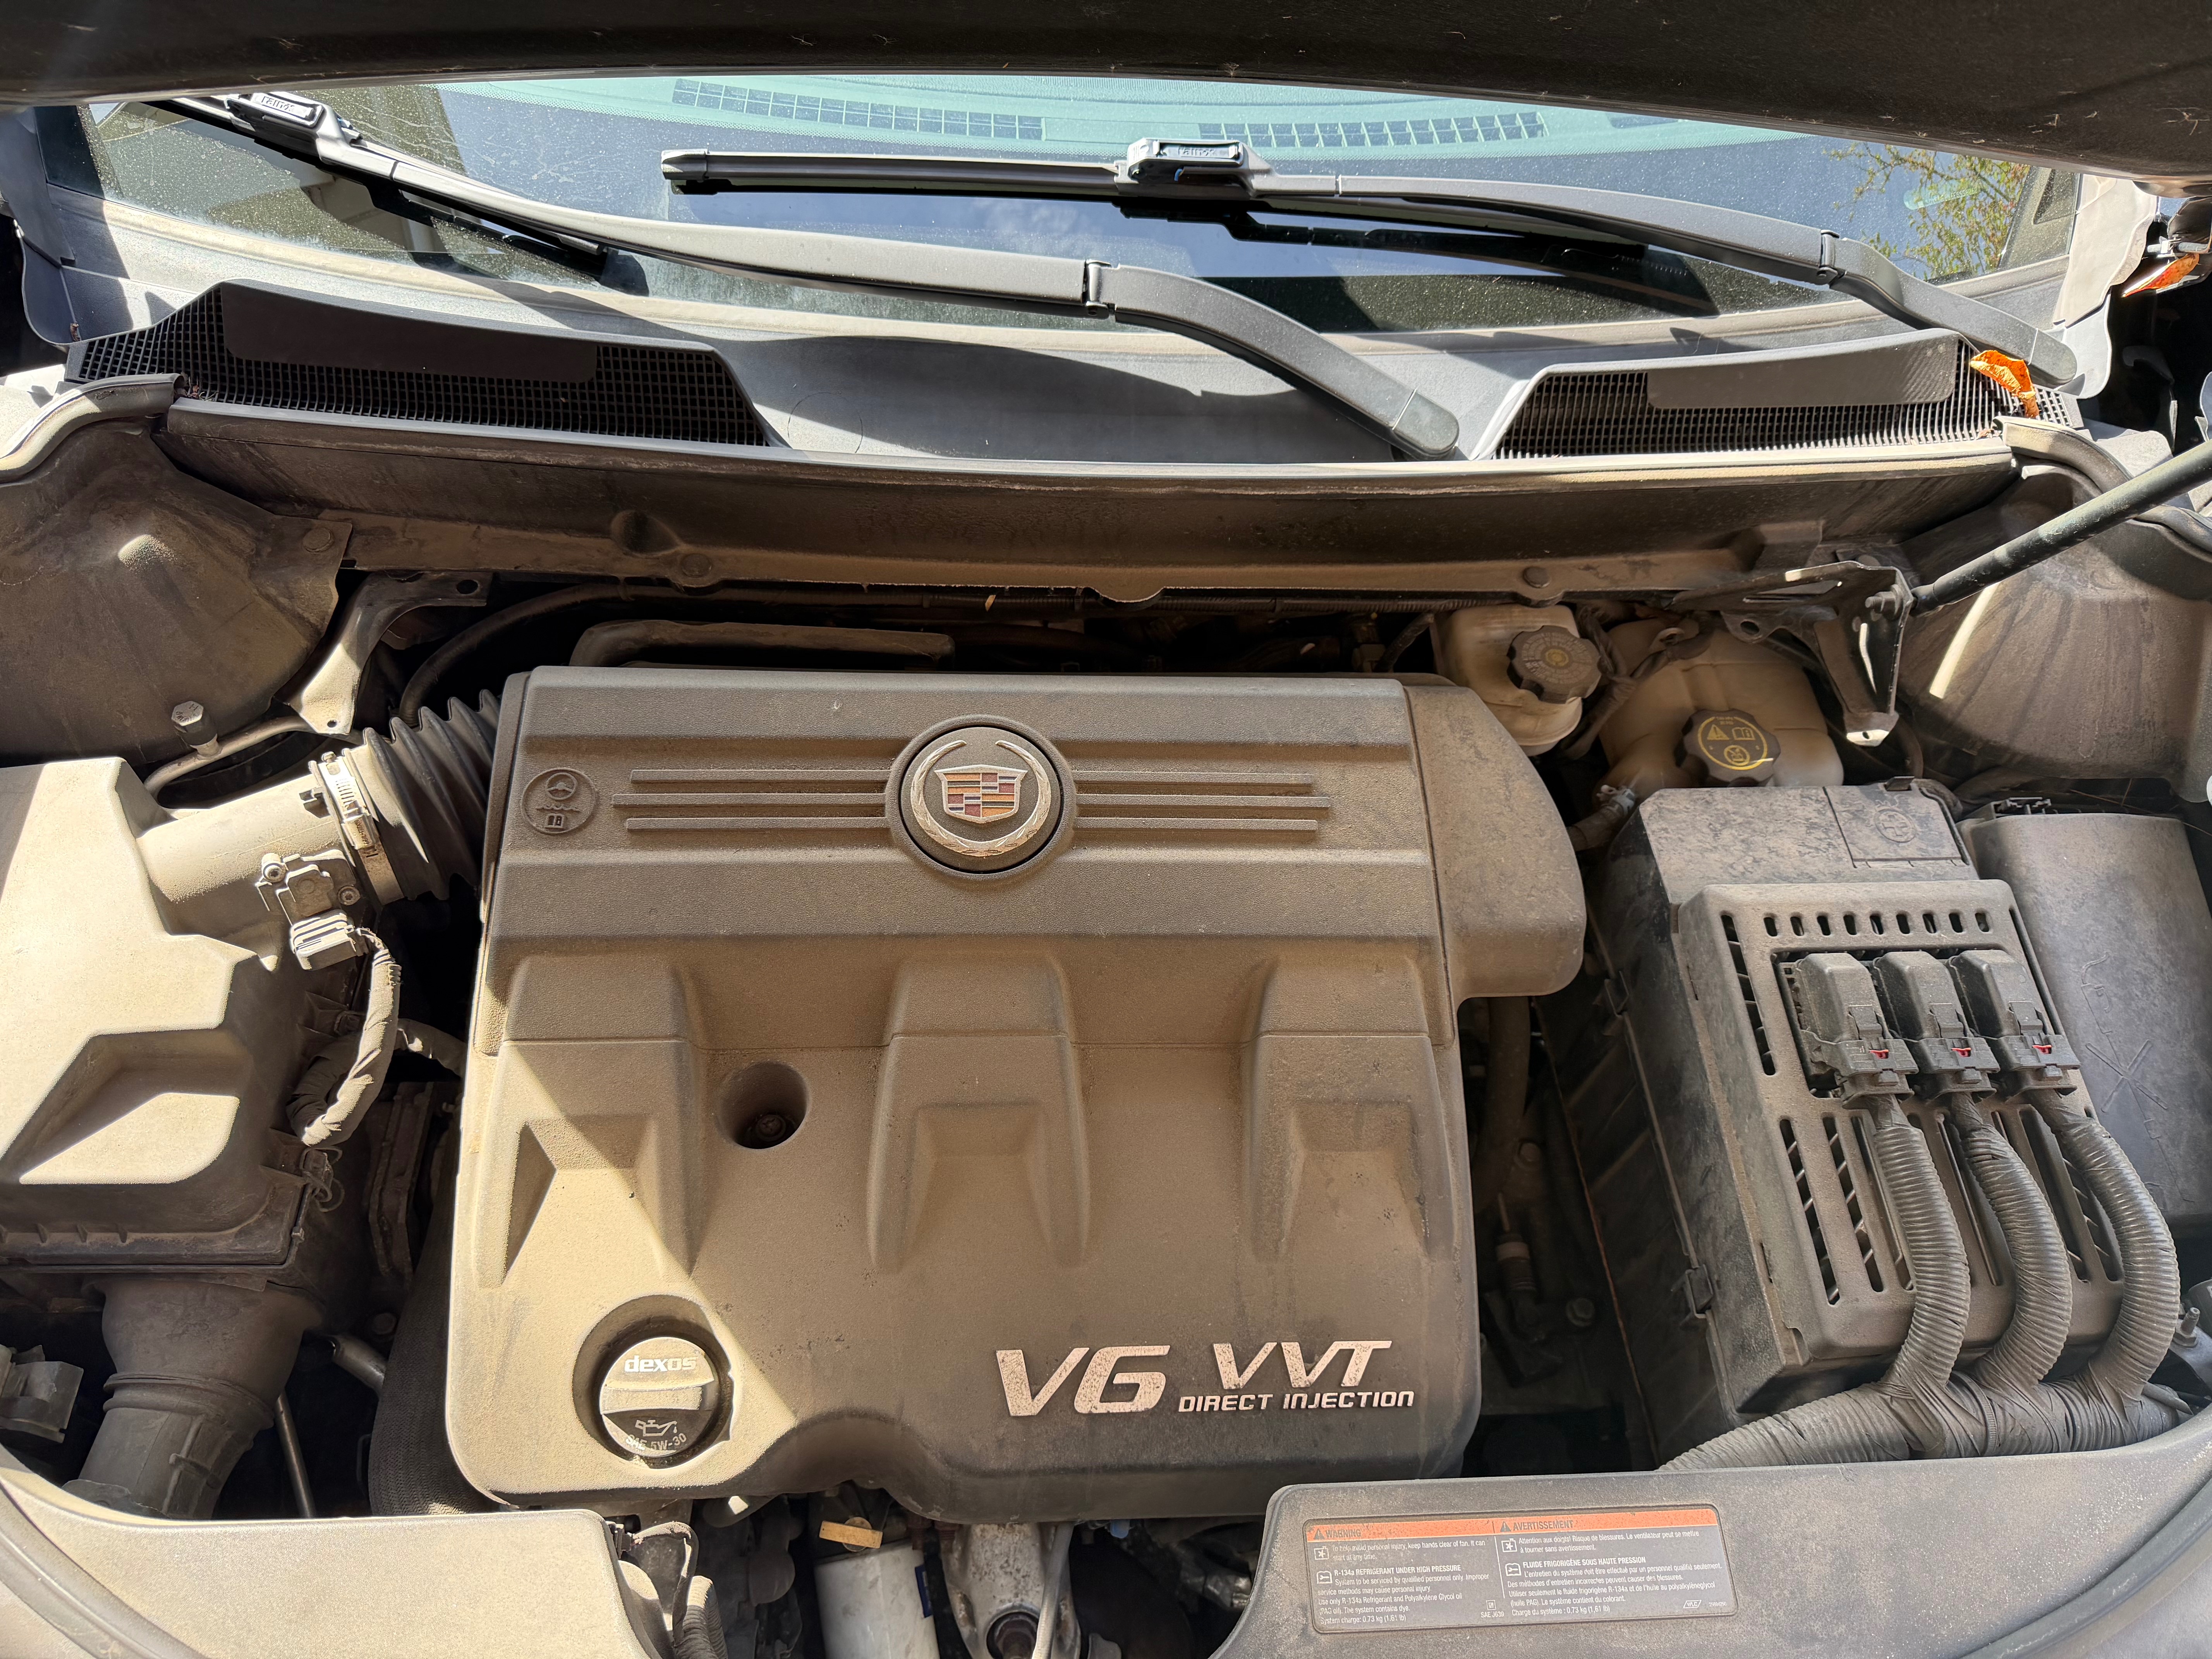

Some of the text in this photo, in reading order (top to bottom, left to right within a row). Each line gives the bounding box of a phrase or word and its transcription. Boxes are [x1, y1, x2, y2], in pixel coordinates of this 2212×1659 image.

[624, 1355, 696, 1372] dexos
[996, 1341, 1392, 1416] V6 VVT
[1178, 1391, 1414, 1412] DIRECT INJECTION
[626, 1432, 687, 1451] SAE 5W-30
[1512, 1519, 1574, 1531] AVERTISSEMENT
[1325, 1528, 1362, 1539] WARNING
[1553, 1535, 1571, 1544] doigts!
[1572, 1534, 1590, 1543] Risque
[1367, 1543, 1390, 1552] personal
[1390, 1542, 1407, 1551] injury,
[1543, 1558, 1581, 1567] FRIGORIGÈNE
[1617, 1556, 1646, 1564] PRESSION
[1355, 1567, 1395, 1575] REFRIGERANT
[1431, 1564, 1462, 1572] PRESSURE
[1560, 1569, 1583, 1577] système
[1647, 1565, 1673, 1573] personnel
[1673, 1564, 1693, 1572] qualifié
[1334, 1578, 1355, 1587] System
[1401, 1576, 1424, 1584] qualified
[1425, 1574, 1451, 1583] personnel
[1465, 1573, 1490, 1581] Improper
[1575, 1577, 1604, 1585] incorrectes
[1605, 1576, 1627, 1584] peuvent
[1391, 1585, 1415, 1594] personal
[1415, 1585, 1432, 1593] injury.
[1578, 1586, 1607, 1595] frigorigène
[1668, 1581, 1716, 1591] polyalkylèneglycol
[1363, 1595, 1393, 1604] Refrigerant
[1404, 1593, 1437, 1603] Polyalkylene
[1438, 1592, 1455, 1601] Glycol
[1510, 1599, 1525, 1607] (huile
[1549, 1597, 1571, 1606] système
[1511, 1609, 1531, 1617] Charge
[1539, 1607, 1563, 1616] système
[1566, 1606, 1579, 1614] 0,73
[1580, 1606, 1587, 1614] kg
[1587, 1605, 1602, 1614] (1,61
[1320, 1617, 1340, 1625] System
[1341, 1616, 1362, 1624] charge:
